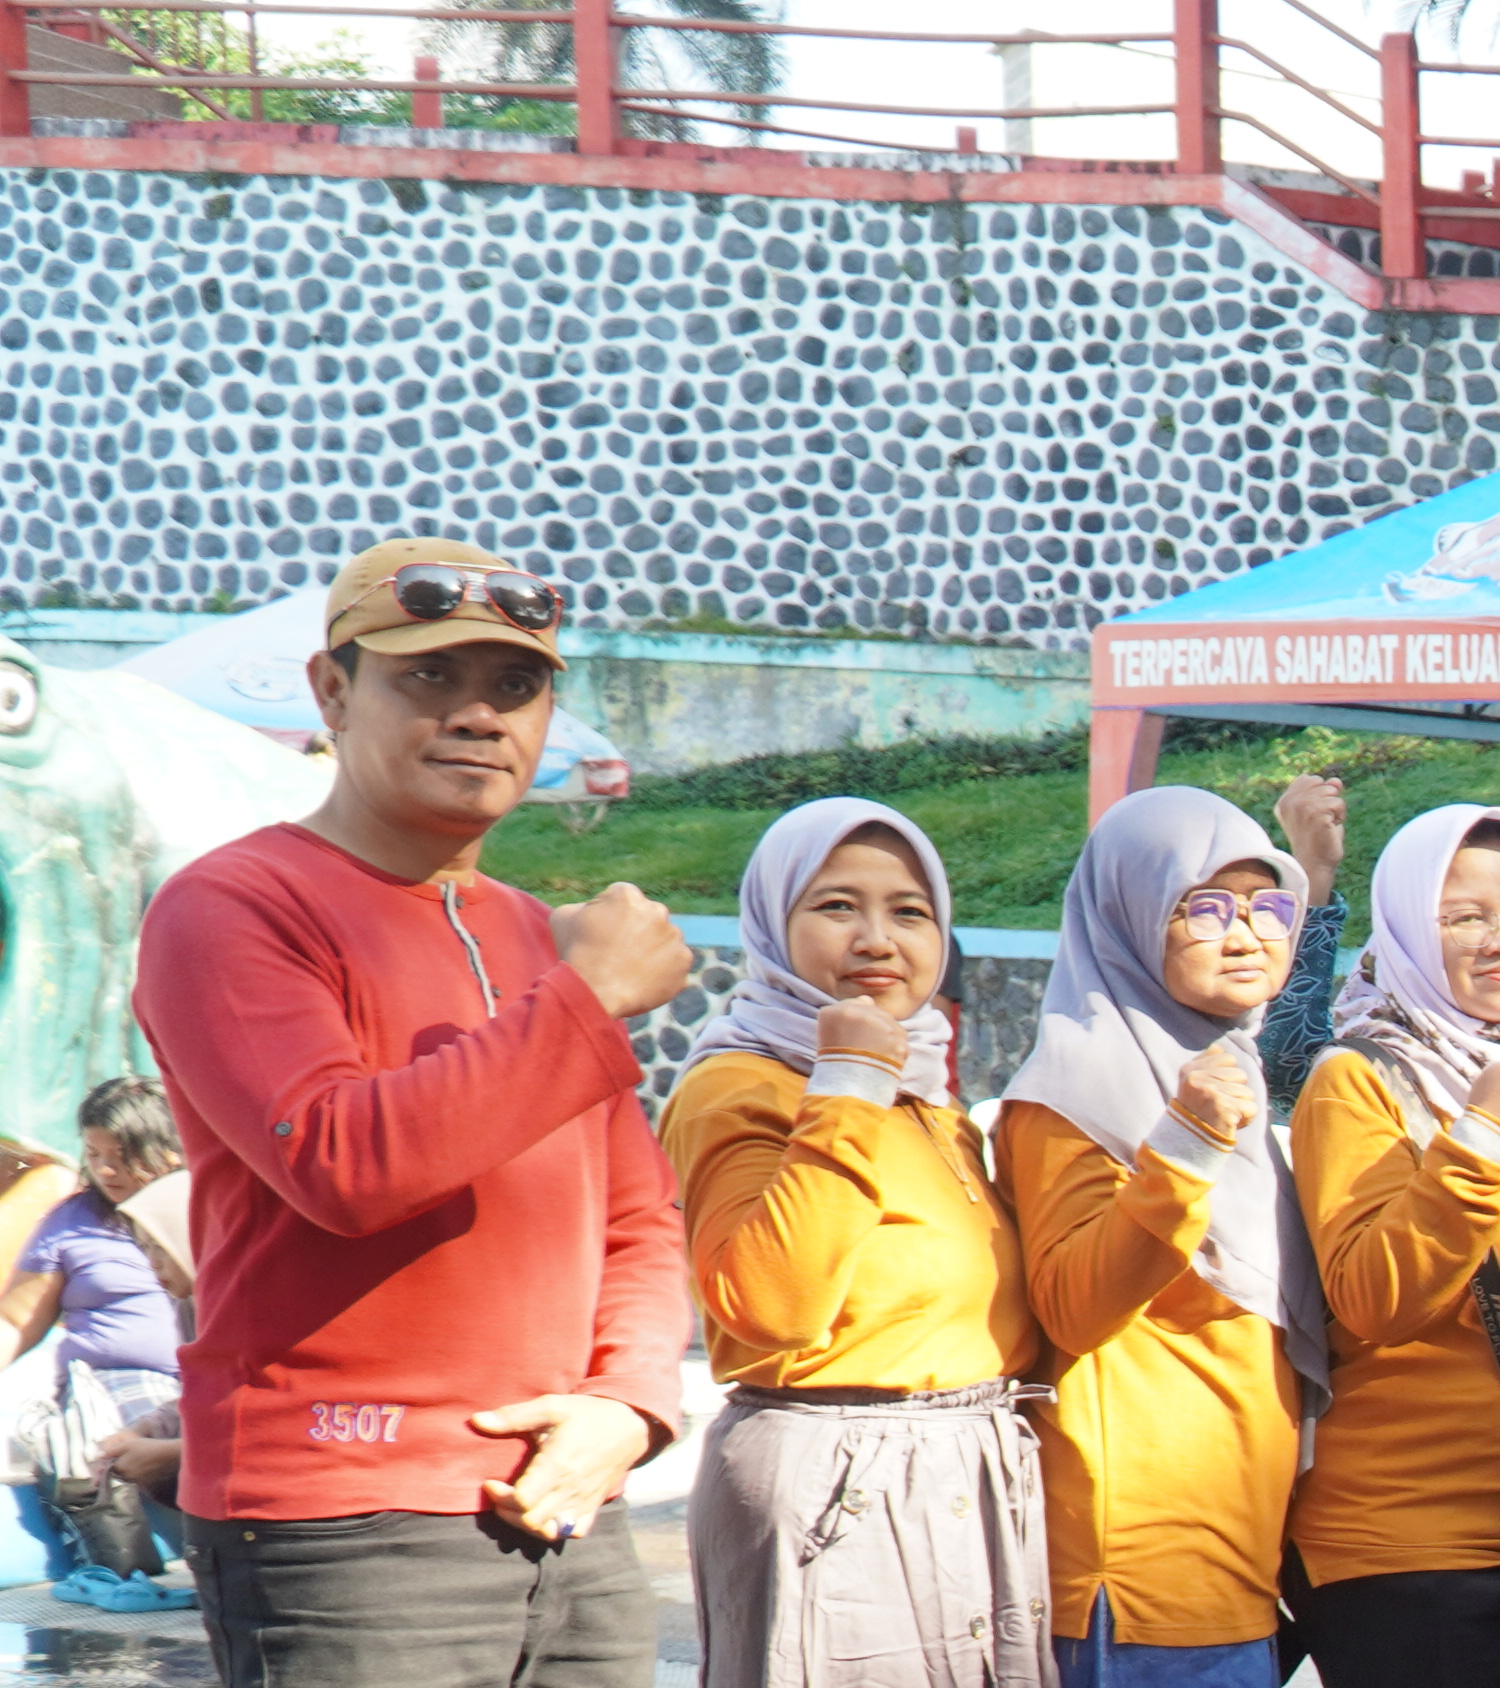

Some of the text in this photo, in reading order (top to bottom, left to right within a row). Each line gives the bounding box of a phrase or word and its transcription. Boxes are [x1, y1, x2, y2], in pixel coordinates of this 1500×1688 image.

[1109, 636, 1270, 688] TERPERCAYA
[1274, 633, 1400, 685] SAHABAT
[1470, 1276, 1494, 1316] LOVE
[308, 1400, 406, 1443] 3507
